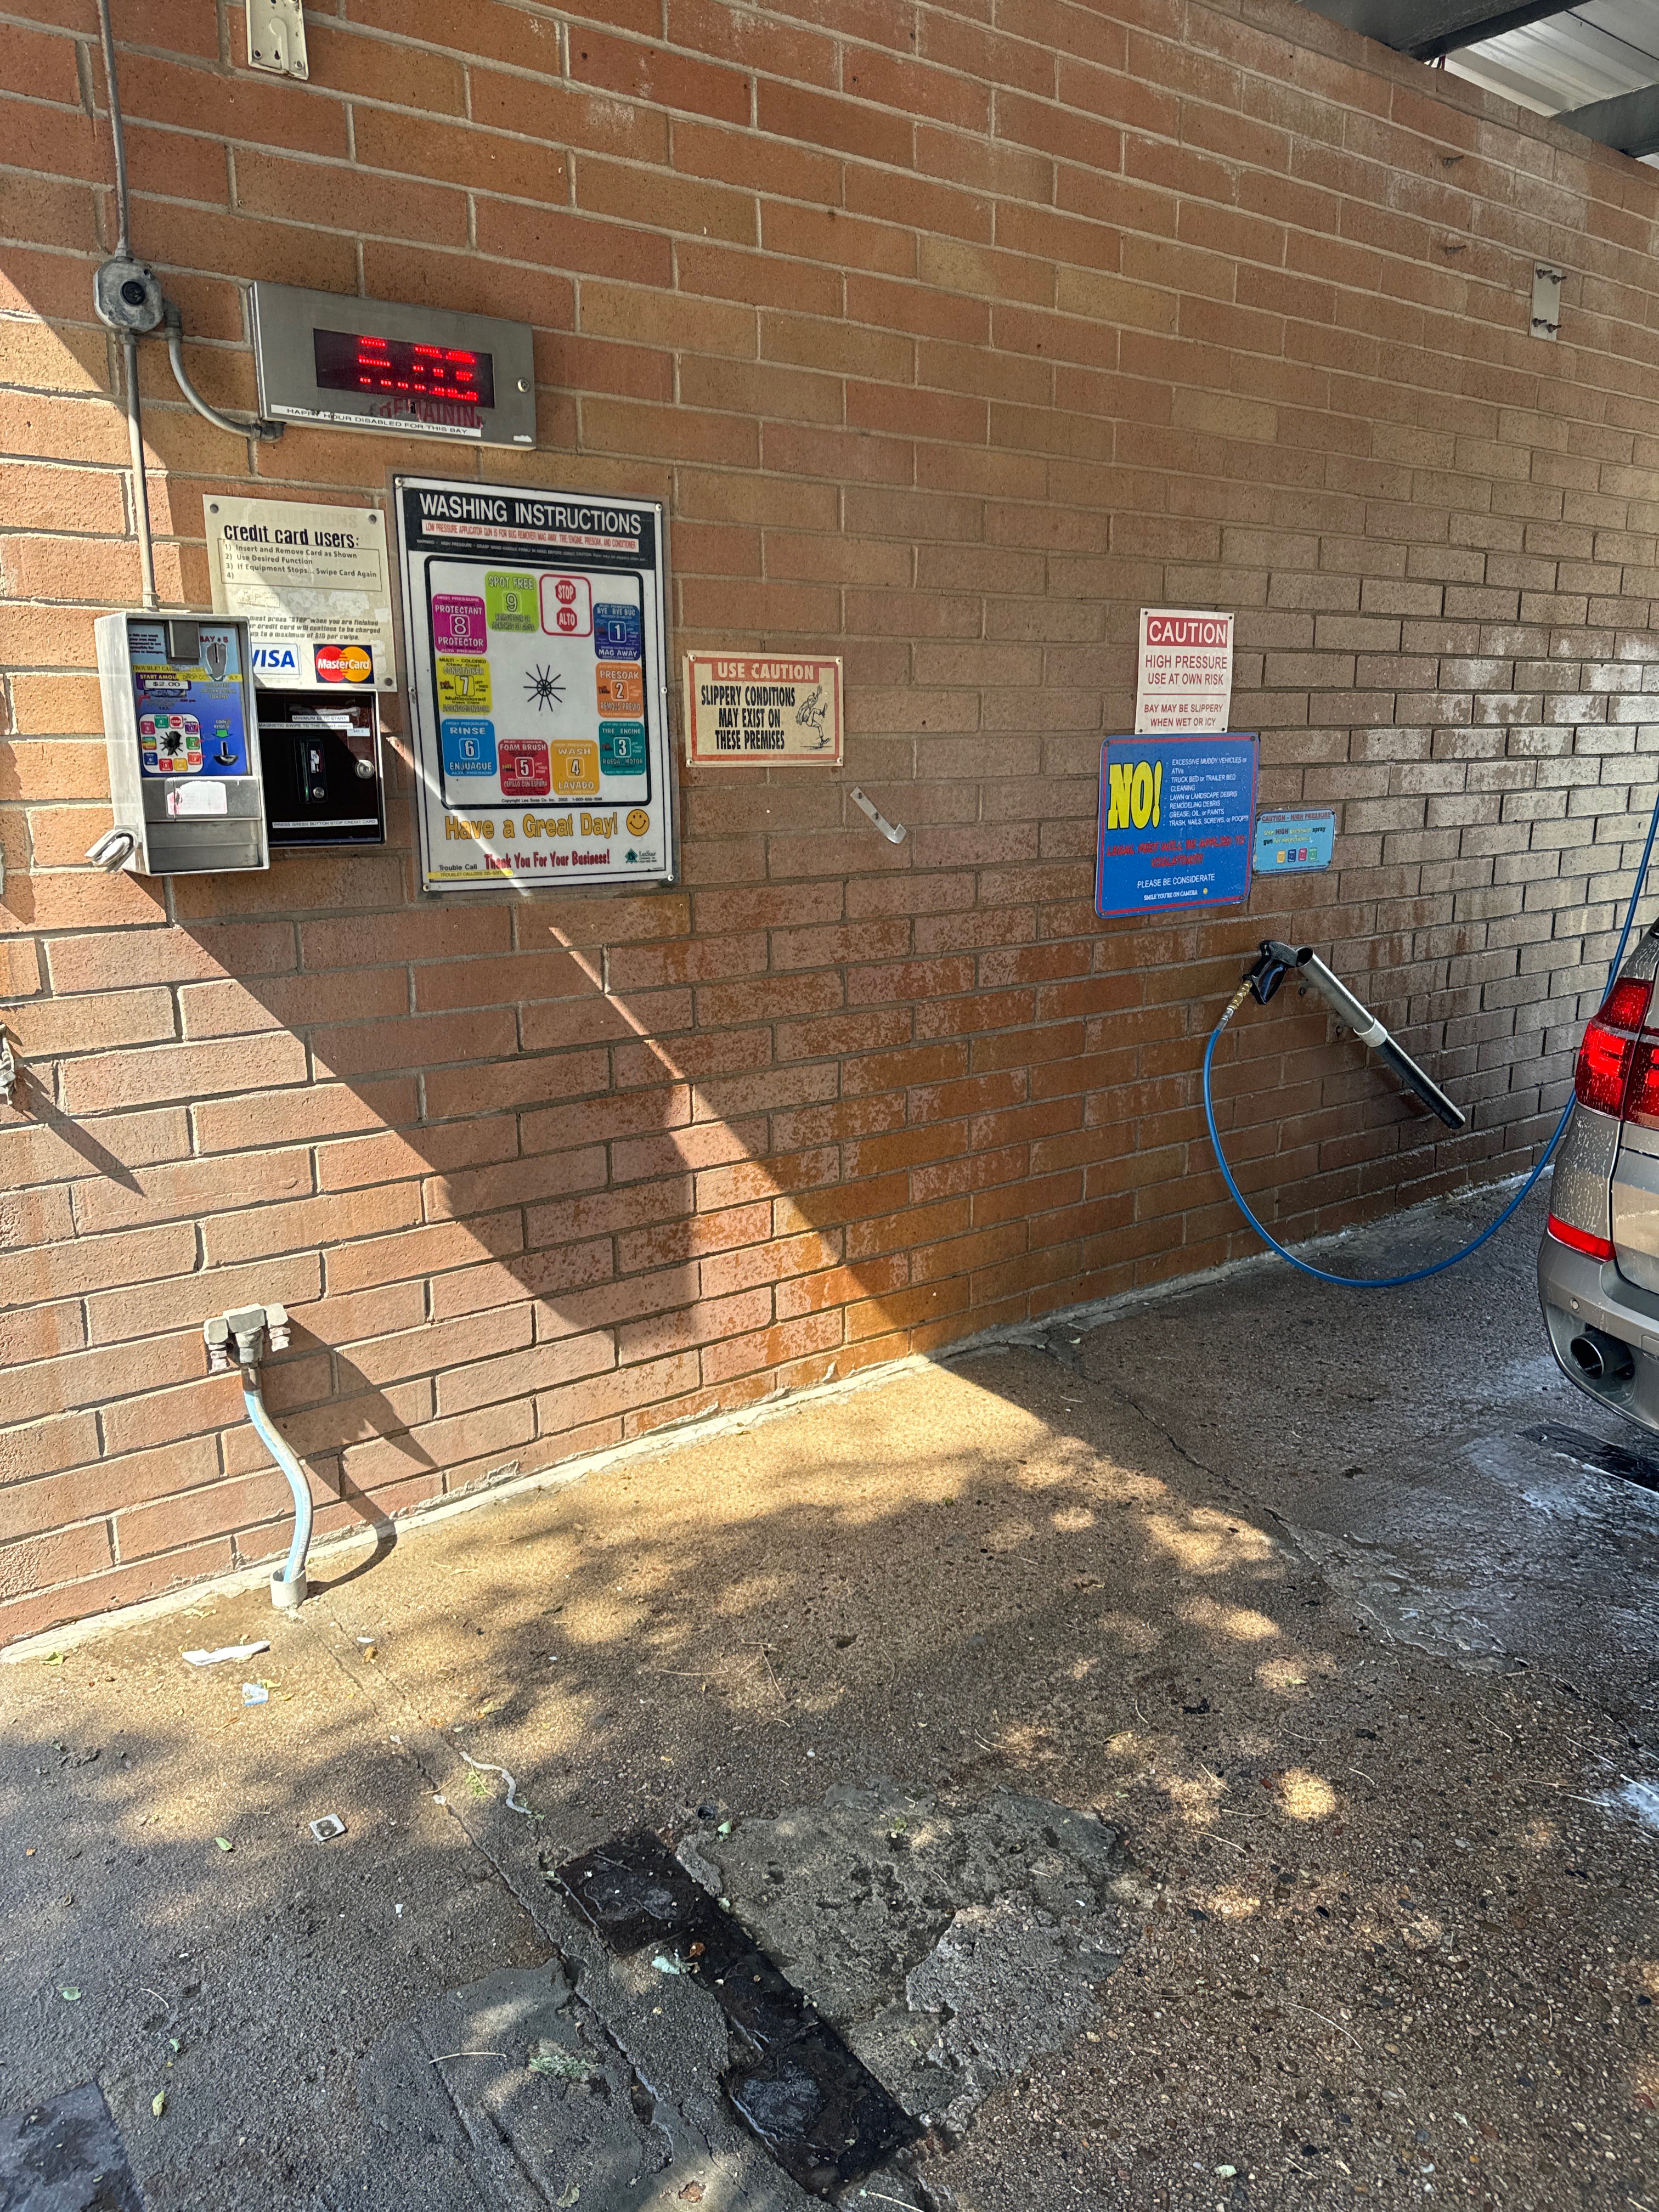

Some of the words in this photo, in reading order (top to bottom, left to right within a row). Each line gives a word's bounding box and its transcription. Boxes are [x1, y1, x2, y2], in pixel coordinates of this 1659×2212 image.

[355, 416, 401, 427] DISABLED
[419, 493, 507, 523] WASHING
[515, 502, 641, 535] INSTRUCTIONS
[223, 522, 269, 543] credit
[274, 526, 308, 545] card
[314, 531, 359, 549] users:
[245, 563, 285, 573] Equipment
[316, 568, 337, 576] Swipe
[357, 571, 376, 579] Again
[489, 575, 510, 588] SPOT
[513, 577, 533, 589] FREE
[558, 584, 573, 600] STOP
[435, 605, 482, 615] PROTECTANT
[505, 592, 518, 612] 9
[454, 617, 466, 635] 8
[558, 614, 575, 626] ALTO
[1149, 620, 1226, 644] CAUTION
[438, 636, 483, 647] PROTECTOR
[317, 657, 370, 670] MasterCard
[1146, 654, 1171, 668] HIGH
[1175, 655, 1227, 669] PRESSURE
[443, 667, 484, 675] CONDITIONER
[600, 670, 639, 679] PRESOAK
[718, 662, 745, 678] USE
[752, 663, 813, 680] CAUTION
[1148, 673, 1166, 684] USE
[1169, 673, 1179, 685] AT
[1182, 673, 1202, 685] OWN
[1205, 674, 1223, 685] RISK
[459, 676, 469, 695] 7
[616, 682, 624, 698] 2
[701, 685, 741, 706] SLIPPERY
[745, 686, 795, 707] CONDITIONS
[600, 702, 620, 710] REMOJO
[623, 703, 640, 711] PREVIO
[1144, 704, 1159, 713] BAY
[1161, 704, 1177, 713] MAY
[1179, 704, 1188, 712] BE
[1190, 704, 1223, 713] SLIPPERY
[719, 708, 738, 727] MAY
[742, 708, 764, 727] EXIST
[768, 709, 780, 727] ON
[1150, 718, 1173, 726] WHEN
[1176, 718, 1191, 726] WET
[1193, 718, 1203, 726] OR
[1205, 718, 1216, 726] ICY
[618, 739, 627, 755] 3
[715, 730, 740, 749] THESE
[744, 730, 785, 749] PREMISES
[465, 740, 475, 757] 6
[449, 762, 492, 770] ENJUAGUE
[520, 760, 529, 776] 5
[571, 759, 580, 776] 4
[558, 781, 594, 789] LAVADO
[1107, 760, 1163, 830] NO!
[444, 815, 495, 840] Have
[502, 819, 515, 838] a
[522, 812, 573, 838] Great
[580, 811, 618, 839] Day!
[1107, 844, 1135, 856] LEGAL
[1138, 842, 1158, 853] FEES
[1161, 840, 1182, 851] WILL
[1186, 839, 1196, 849] BE
[1198, 836, 1232, 848] APPLIED
[484, 853, 511, 869] Thank
[514, 853, 531, 868] You
[533, 851, 548, 867] For
[549, 851, 569, 867] Your
[571, 849, 610, 866] Business!
[1137, 879, 1161, 888] PLEASE
[1172, 873, 1215, 885] CONSIDERATE
